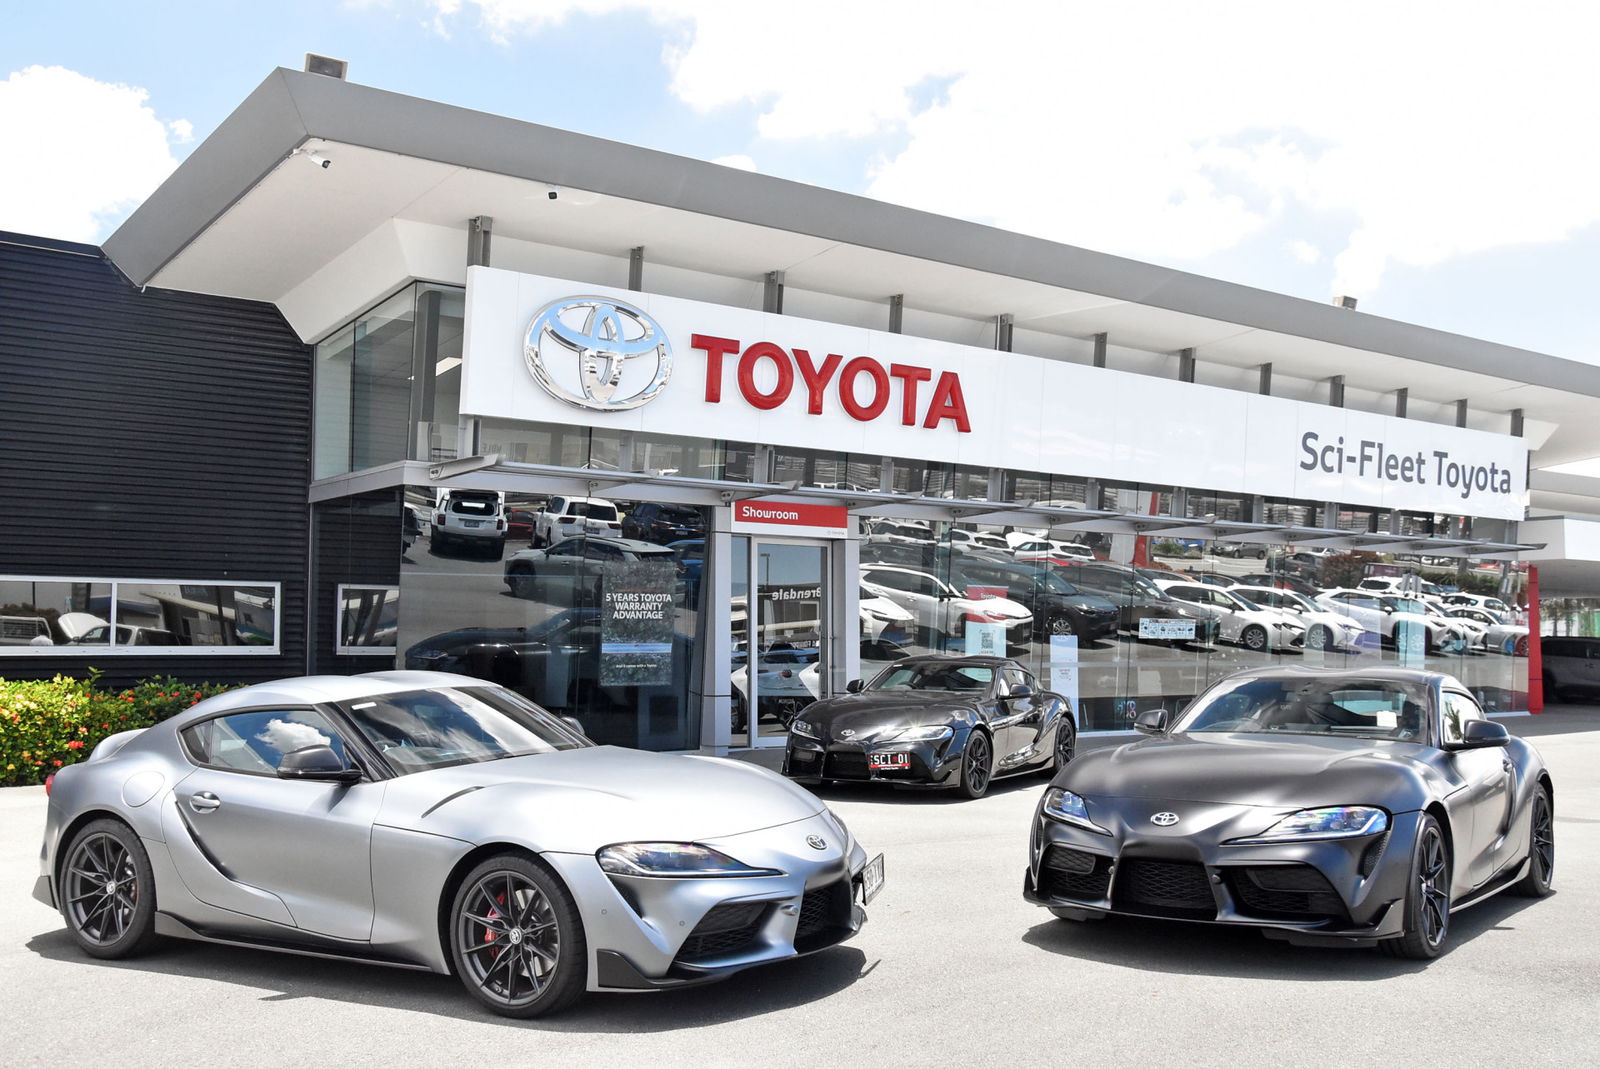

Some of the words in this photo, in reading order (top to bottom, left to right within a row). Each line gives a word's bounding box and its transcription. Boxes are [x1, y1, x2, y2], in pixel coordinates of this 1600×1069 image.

[691, 333, 972, 433] TOYOTA
[1300, 431, 1426, 484] Sci-Fleet
[1433, 450, 1511, 499] Toyota
[742, 506, 799, 520] Showroom
[605, 593, 612, 602] 5
[612, 593, 639, 602] YEARS
[640, 593, 672, 602] TOYOTA
[615, 602, 663, 611] WARRANTY
[613, 611, 664, 620] ADVANTAGE
